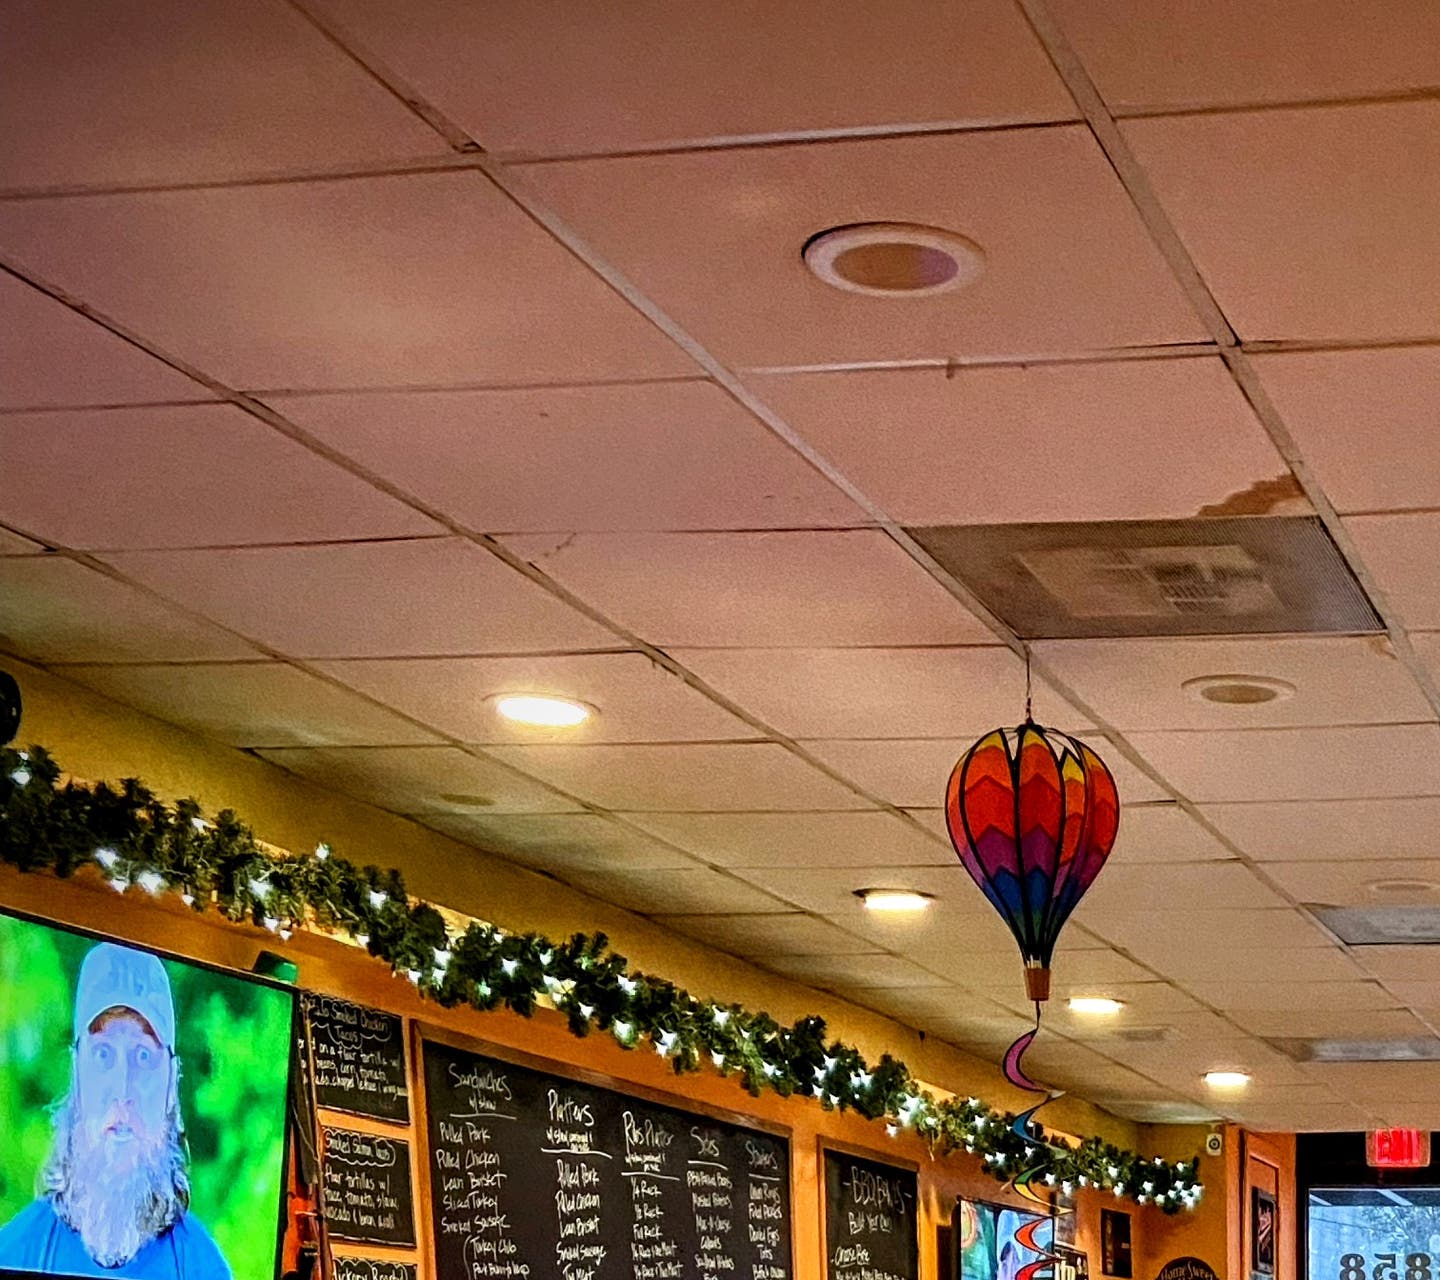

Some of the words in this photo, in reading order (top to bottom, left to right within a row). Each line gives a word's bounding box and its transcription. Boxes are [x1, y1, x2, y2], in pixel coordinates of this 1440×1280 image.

[449, 1063, 512, 1101] Sandwiches
[548, 1089, 594, 1126] Platters
[466, 1122, 491, 1143] Pork
